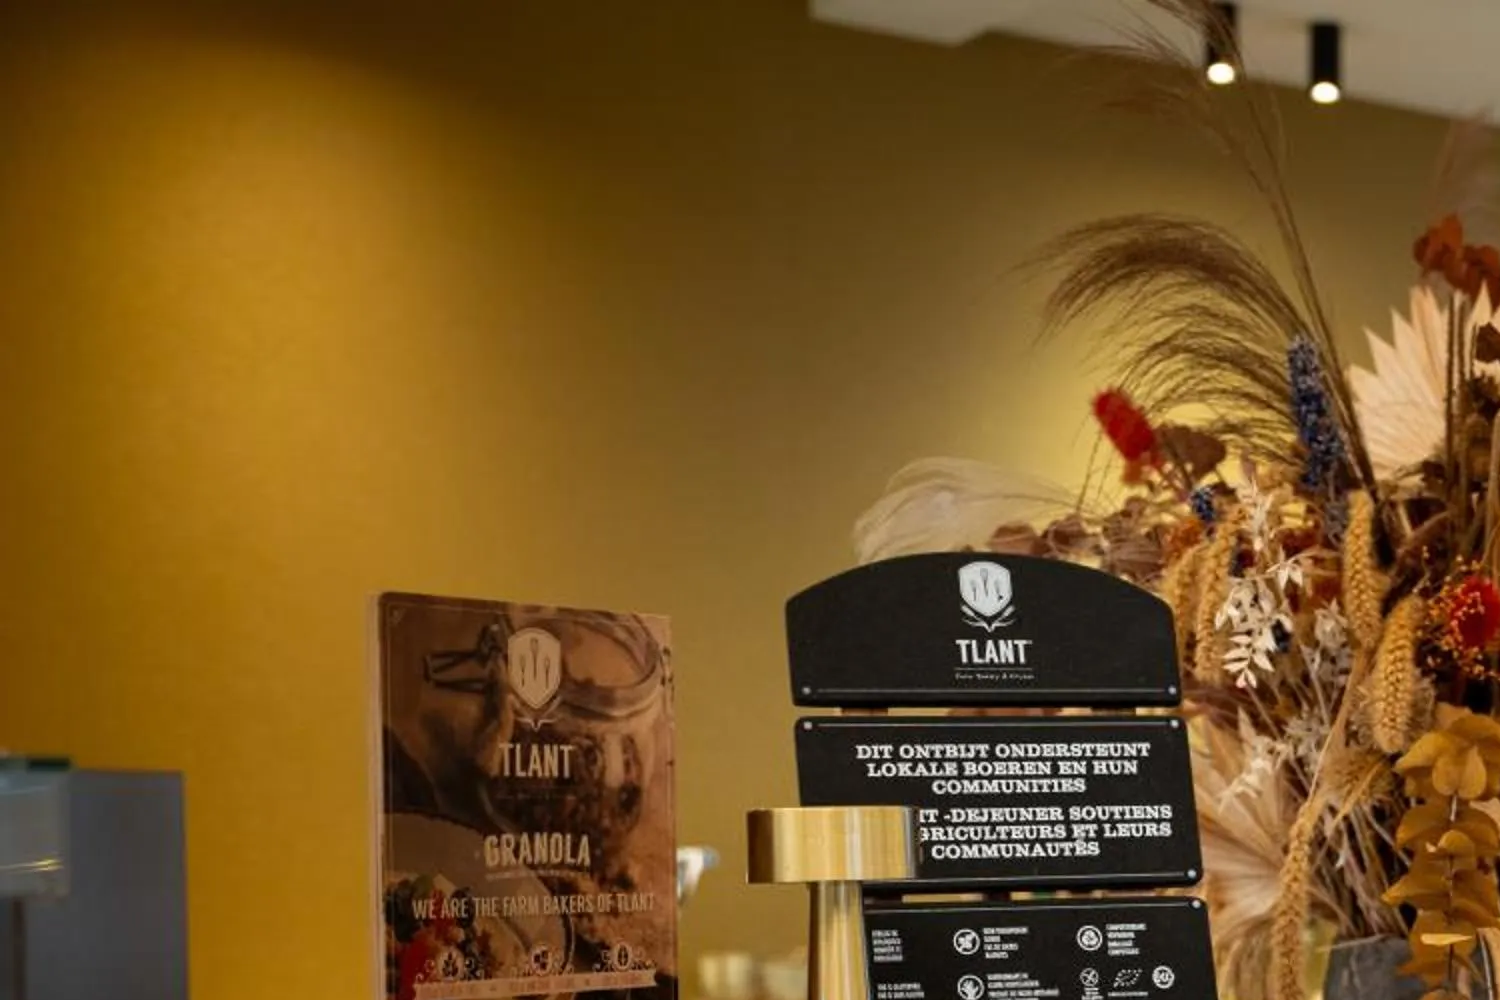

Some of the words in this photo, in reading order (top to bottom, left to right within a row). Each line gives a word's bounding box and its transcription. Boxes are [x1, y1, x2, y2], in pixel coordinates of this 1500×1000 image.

[955, 639, 1027, 664] TLANT
[856, 744, 894, 759] DIT
[899, 744, 990, 759] ONTBIJT
[995, 743, 1151, 758] ONDERSTEUNT
[499, 743, 577, 779] TLANT
[866, 762, 958, 777] LOKALE
[962, 760, 1052, 776] BOEREN
[1057, 760, 1087, 775] EN
[1091, 760, 1138, 775] HUN
[932, 779, 1087, 795] COMMUNITIES
[1069, 805, 1173, 820] SOUTIENS
[1072, 823, 1099, 839] ET
[1103, 822, 1173, 837] LEURS
[484, 831, 591, 867] GRANOLA
[412, 898, 436, 919] WE
[440, 897, 469, 919] ARE
[473, 896, 498, 917] THE
[503, 895, 539, 916] FARM
[543, 893, 595, 915] BAKERS
[598, 893, 614, 913] OF
